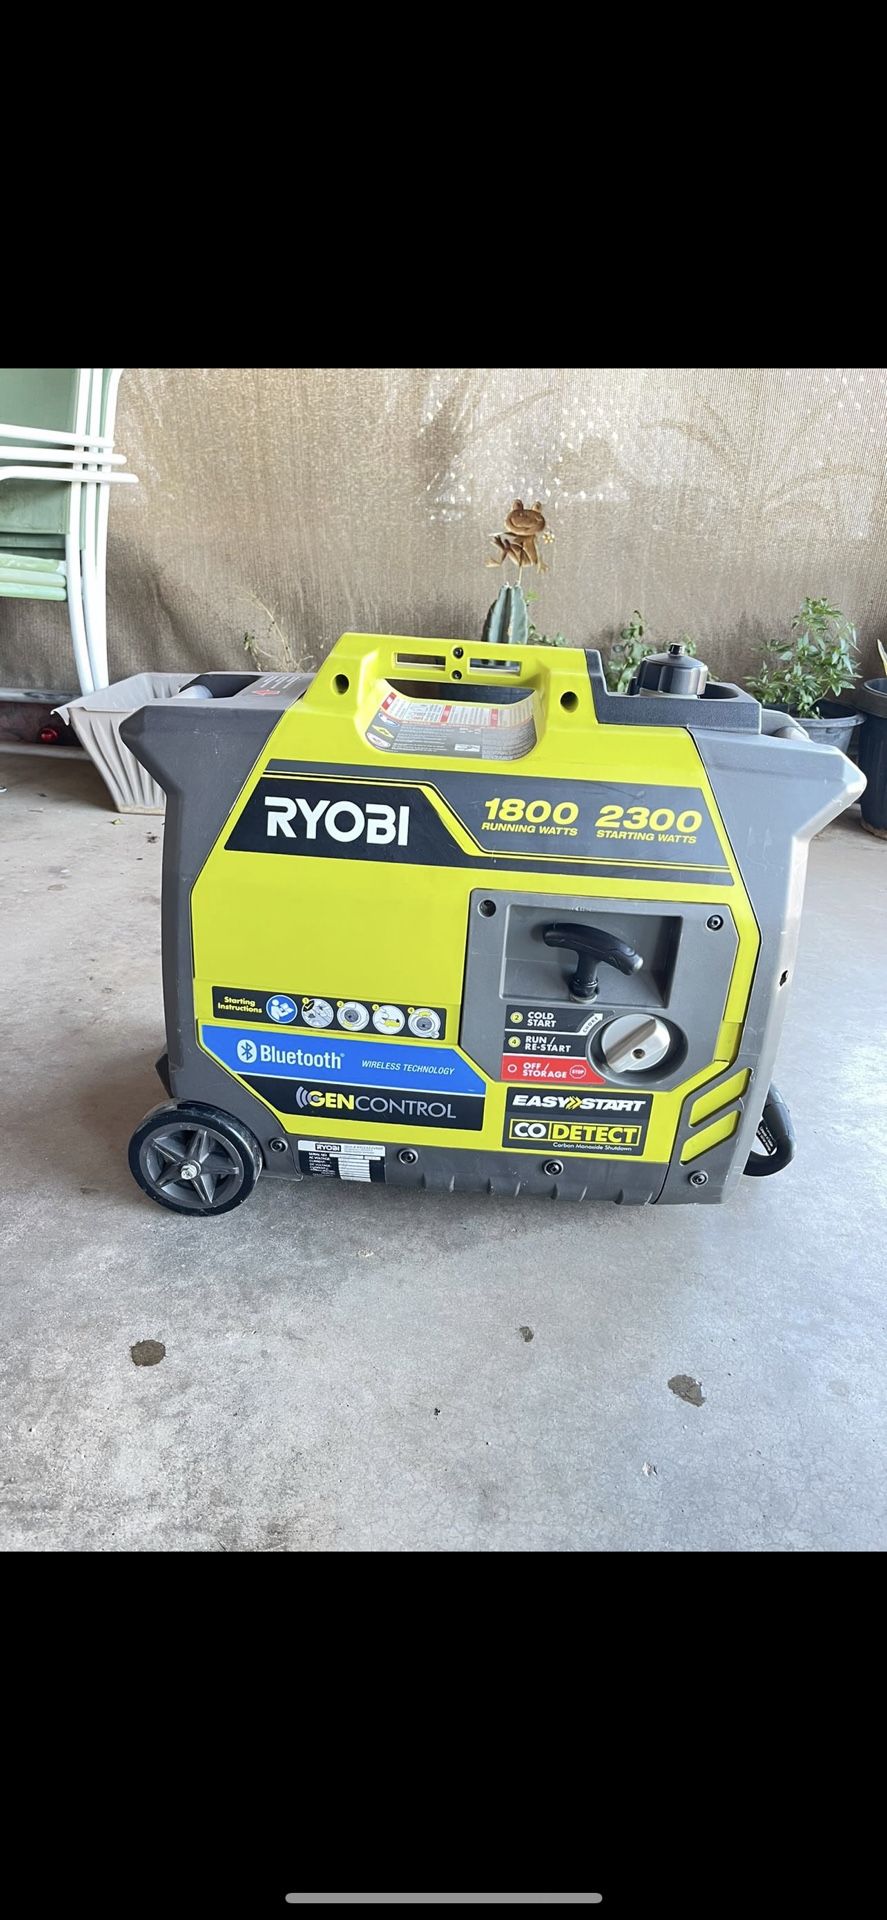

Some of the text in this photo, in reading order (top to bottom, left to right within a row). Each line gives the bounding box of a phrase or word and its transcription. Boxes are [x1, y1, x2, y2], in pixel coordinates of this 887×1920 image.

[484, 797, 580, 826] 1800
[264, 796, 410, 846] RYOBI
[595, 804, 702, 833] 2300
[481, 822, 578, 837] RUNNING WATTS
[596, 830, 697, 844] STARTING WATTS
[224, 996, 256, 1007] Starting
[217, 1002, 263, 1014] Instructions
[527, 1011, 554, 1020] COLD
[527, 1018, 557, 1028] START
[525, 1035, 547, 1044] RUN
[524, 1043, 571, 1053] RE-START
[361, 1059, 455, 1076] WIRELESS TECHNOLOGY
[523, 1062, 542, 1070] OFF
[522, 1070, 567, 1079] STORAGE
[308, 1089, 456, 1119] GENCONTROL
[512, 1094, 646, 1112] EASY START
[514, 1121, 638, 1143] CO DETECT
[316, 1144, 340, 1152] RYOBI
[552, 1142, 632, 1152] Carbon Monoxide Shutdown
